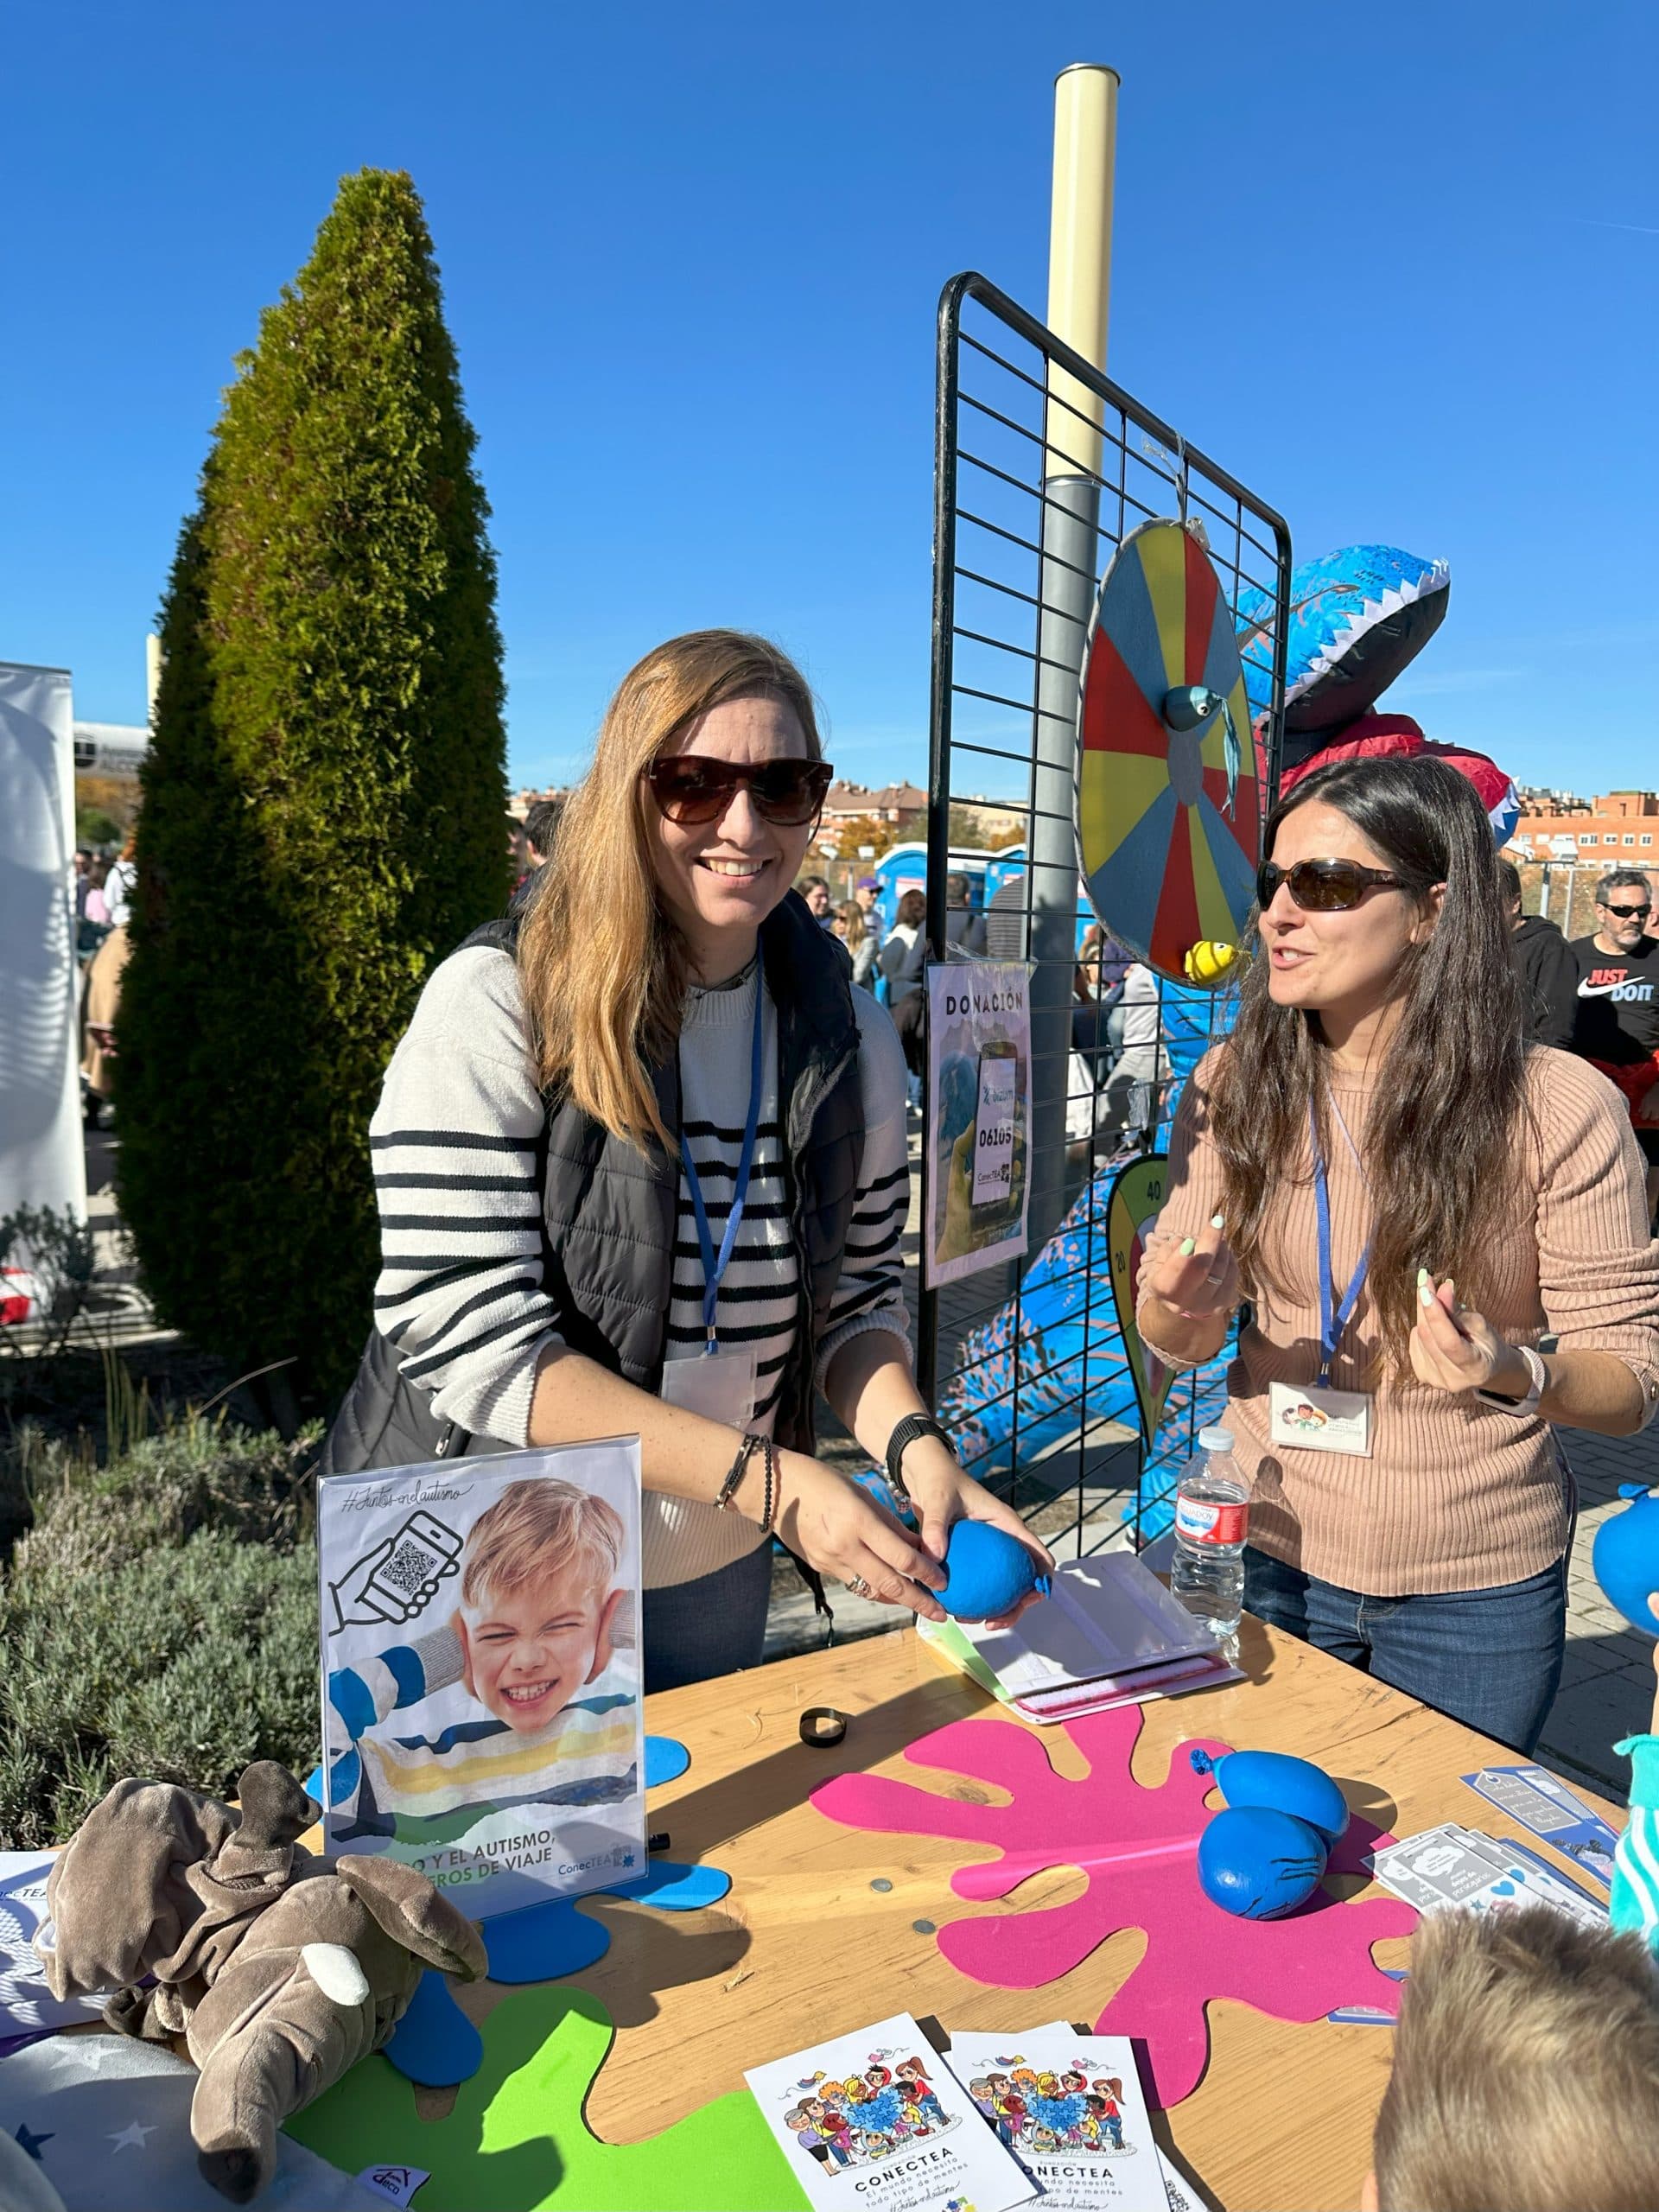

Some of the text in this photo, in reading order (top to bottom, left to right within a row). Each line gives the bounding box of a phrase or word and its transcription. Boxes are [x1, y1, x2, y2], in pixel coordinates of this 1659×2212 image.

[1588, 969, 1628, 985] JUST
[946, 986, 1023, 1015] DONACIÓN
[1147, 1179, 1161, 1201] 40
[432, 1853, 442, 1869] Y
[449, 1849, 467, 1866] EL
[474, 1830, 556, 1860] AUTISMO,
[479, 1860, 499, 1878] DE
[505, 1847, 552, 1871] VIAJE
[855, 2147, 952, 2192] CONECTEA
[1022, 2165, 1114, 2178] ONECTEA
[866, 2196, 889, 2208] todo
[893, 2185, 913, 2196] tipo
[933, 2163, 968, 2180] mentes
[866, 2190, 876, 2199] El
[880, 2177, 912, 2193] mundo
